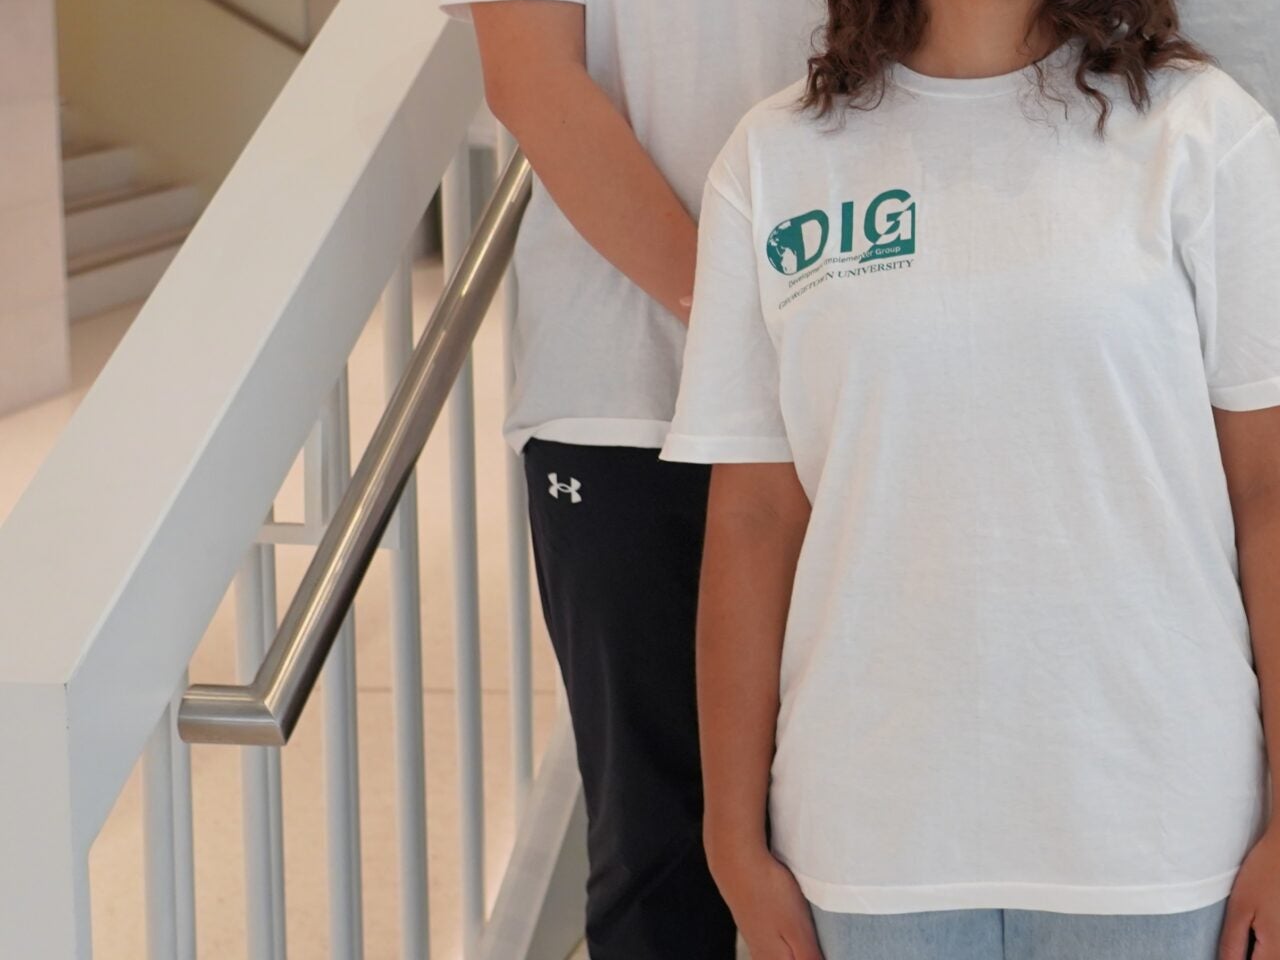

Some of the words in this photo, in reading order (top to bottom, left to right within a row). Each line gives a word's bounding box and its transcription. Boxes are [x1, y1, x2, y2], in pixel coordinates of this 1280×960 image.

[766, 188, 916, 276] DIG
[875, 245, 901, 256] Group
[838, 258, 914, 279] UNIVERSITY
